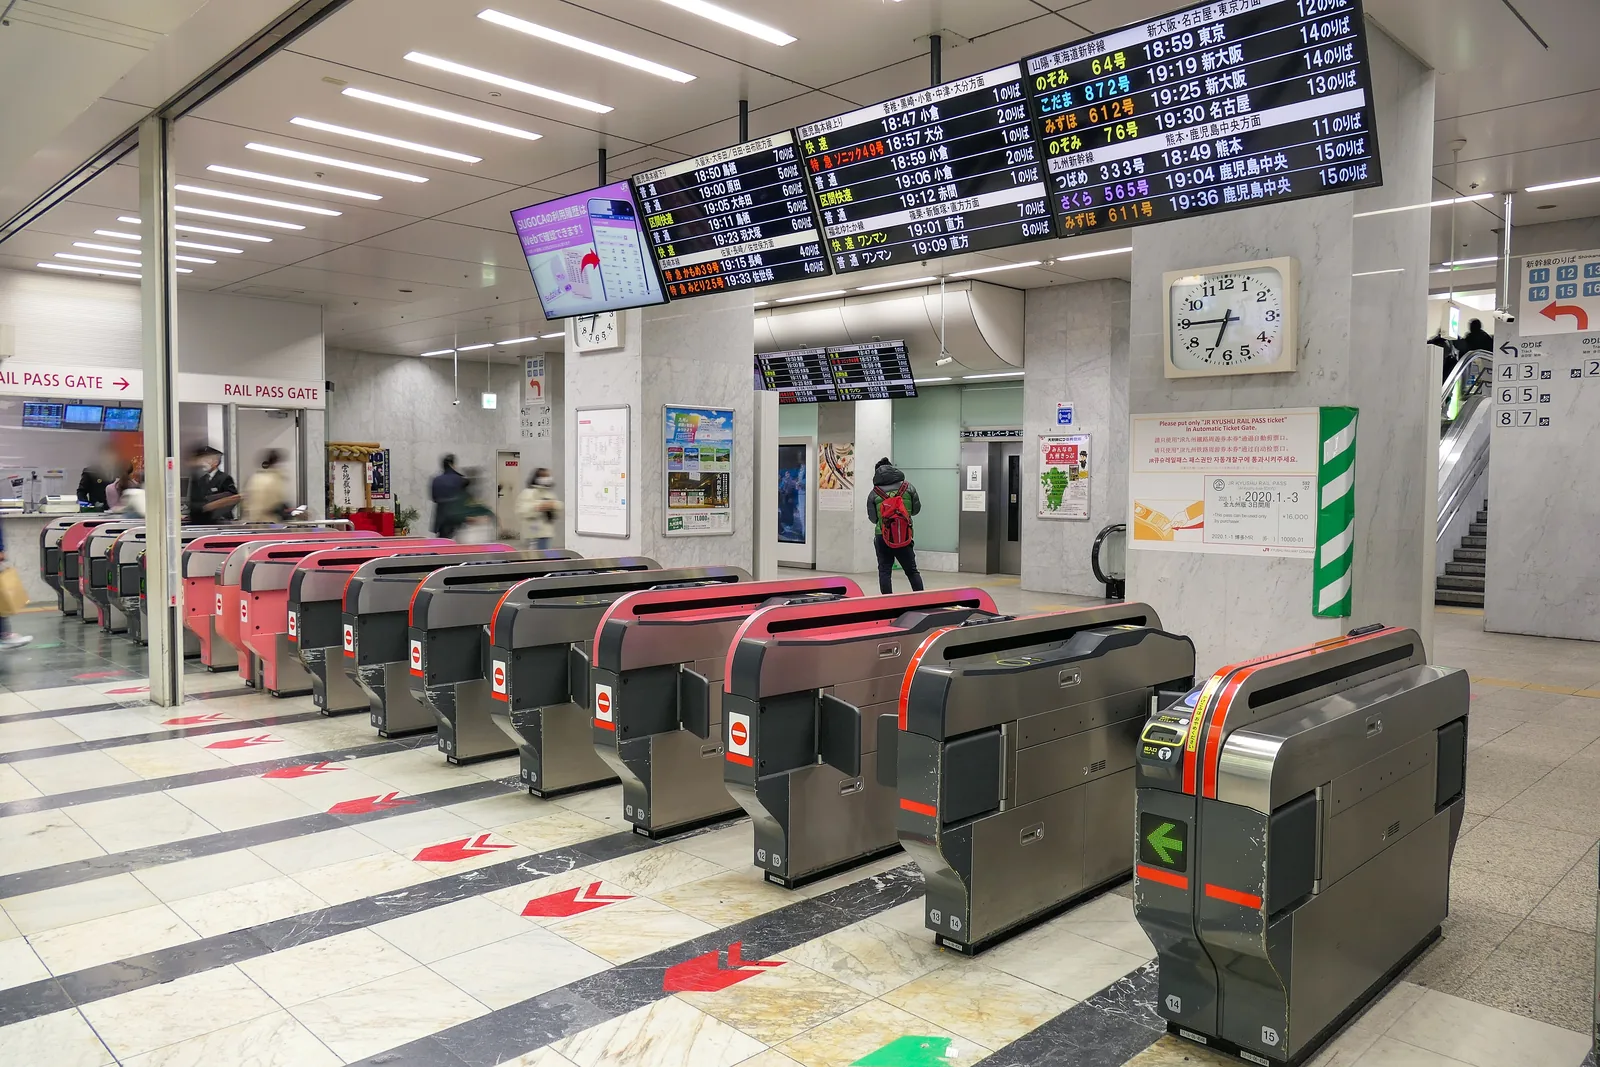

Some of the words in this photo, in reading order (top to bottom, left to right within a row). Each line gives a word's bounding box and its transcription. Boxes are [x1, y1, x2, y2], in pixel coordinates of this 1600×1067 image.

[1036, 72, 1069, 90] のぞみ
[1092, 52, 1126, 76] 64号
[1143, 33, 1193, 60] 18:59
[1197, 24, 1226, 47] 東京
[1041, 92, 1072, 112] こだま
[1085, 75, 1130, 101] 872号
[1147, 57, 1197, 84] 19:19
[1201, 45, 1244, 70] 新大阪
[1300, 16, 1350, 45] 14のりば
[1046, 113, 1077, 133] みずほ
[1089, 98, 1134, 123] 612号
[1151, 82, 1201, 107] 19:25
[1206, 70, 1247, 95] 新大阪
[1303, 44, 1353, 70] 14のりば
[805, 137, 829, 154] 快速
[881, 111, 916, 132] 18:47
[920, 105, 940, 123] 小倉
[993, 82, 1021, 102] 1のりば
[1050, 135, 1081, 154] のぞみ
[1104, 121, 1138, 143] 76号
[1155, 106, 1205, 130] 19:30
[1210, 94, 1251, 119] 名古屋
[1306, 69, 1357, 96] 13のりば
[886, 131, 921, 151] 18:57
[924, 126, 944, 143] 大分
[997, 104, 1025, 124] 2のりば
[814, 174, 838, 191] 普通
[891, 151, 926, 171] 18:59
[929, 145, 949, 161] 小倉
[1002, 126, 1030, 144] 1のりば
[1056, 172, 1088, 189] つばめ
[1100, 158, 1145, 180] 333号
[1161, 144, 1211, 167] 18:49
[1215, 137, 1243, 158] 熊本
[1312, 113, 1362, 137] 11のりば
[1053, 152, 1094, 171] 九州新幹線
[694, 167, 721, 183] 18:50
[819, 188, 853, 207] 区間快速
[896, 170, 931, 190] 19:06
[934, 165, 953, 181] 小倉
[1006, 147, 1034, 164] 2のりば
[1060, 190, 1092, 210] さくら
[1104, 180, 1149, 202] 565号
[1165, 167, 1215, 190] 19:04
[1219, 152, 1288, 180] 鹿児島中央
[1316, 138, 1364, 162] 15のりば
[699, 183, 725, 198] 19:00
[726, 179, 742, 193] 原田
[824, 208, 847, 225] 普通
[900, 190, 935, 208] 19:12
[938, 184, 957, 200] 赤間
[1011, 168, 1038, 185] 1のりば
[704, 200, 730, 215] 19:05
[731, 194, 752, 209] 大牟田
[1065, 213, 1097, 231] みずほ
[1108, 202, 1153, 224] 611号
[1170, 189, 1219, 212] 19:36
[1223, 177, 1291, 204] 鹿児島中央
[1319, 164, 1367, 186] 15のりば
[708, 216, 734, 231] 19:11
[832, 234, 854, 252] 快速
[857, 232, 887, 247] ワンマン
[908, 221, 942, 237] 19:01
[945, 215, 965, 230] 直方
[1017, 201, 1045, 218] 7のりば
[713, 231, 739, 246] 19:23
[741, 227, 762, 241] 羽犬塚
[837, 252, 859, 269] 普通
[862, 250, 892, 264] ワンマン
[912, 239, 947, 256] 19:09
[950, 234, 969, 250] 直方
[1022, 221, 1050, 237] 8のりば
[720, 256, 747, 271] 19:15
[748, 253, 763, 267] 長崎
[1526, 255, 1577, 268] 新幹線のりば
[725, 272, 751, 287] 19:33
[752, 268, 774, 283] 佐世保
[1532, 271, 1545, 281] 11
[1560, 268, 1575, 278] 12
[1587, 265, 1600, 275] 13
[1203, 286, 1215, 297] 11
[1219, 279, 1234, 290] 12
[1242, 281, 1248, 291] 1
[1532, 288, 1546, 299] 14
[1560, 286, 1574, 296] 15
[1587, 283, 1600, 294] 16
[1256, 291, 1266, 302] 2
[1189, 300, 1203, 311] 10
[1265, 310, 1275, 321] 3
[1182, 319, 1191, 329] 9
[1190, 337, 1199, 348] 8
[1257, 331, 1267, 342] 4
[1206, 348, 1215, 358] 7
[1223, 350, 1232, 360] 6
[1240, 345, 1250, 356] 5
[1502, 366, 1512, 379] 4
[1523, 365, 1533, 378] 3
[1589, 362, 1600, 375] 2
[24, 373, 59, 387] PASS
[65, 375, 103, 389] GATE
[224, 383, 252, 396] RAIL
[256, 384, 284, 398] PASS
[288, 387, 318, 400] GATE
[1502, 389, 1512, 402] 6
[1523, 388, 1532, 401] 5
[1501, 412, 1511, 424] 8
[1522, 412, 1532, 424] 7
